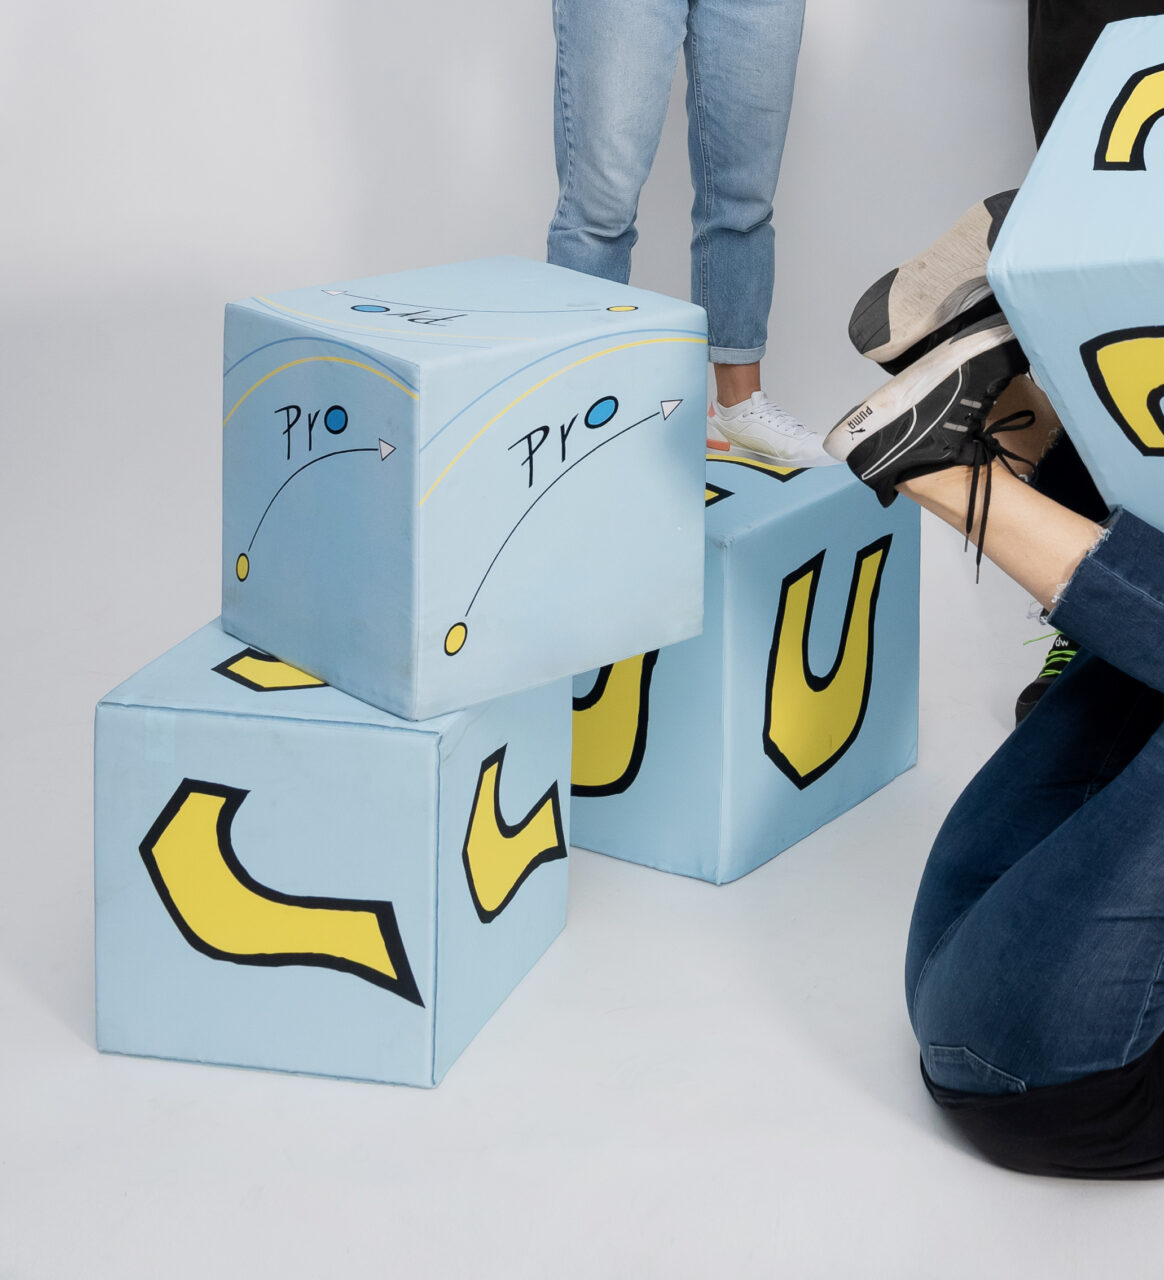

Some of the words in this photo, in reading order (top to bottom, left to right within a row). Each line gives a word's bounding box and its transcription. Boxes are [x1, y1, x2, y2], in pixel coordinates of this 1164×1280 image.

[274, 404, 349, 461] Pro
[507, 394, 619, 488] Pro
[847, 405, 874, 430] PUMA
